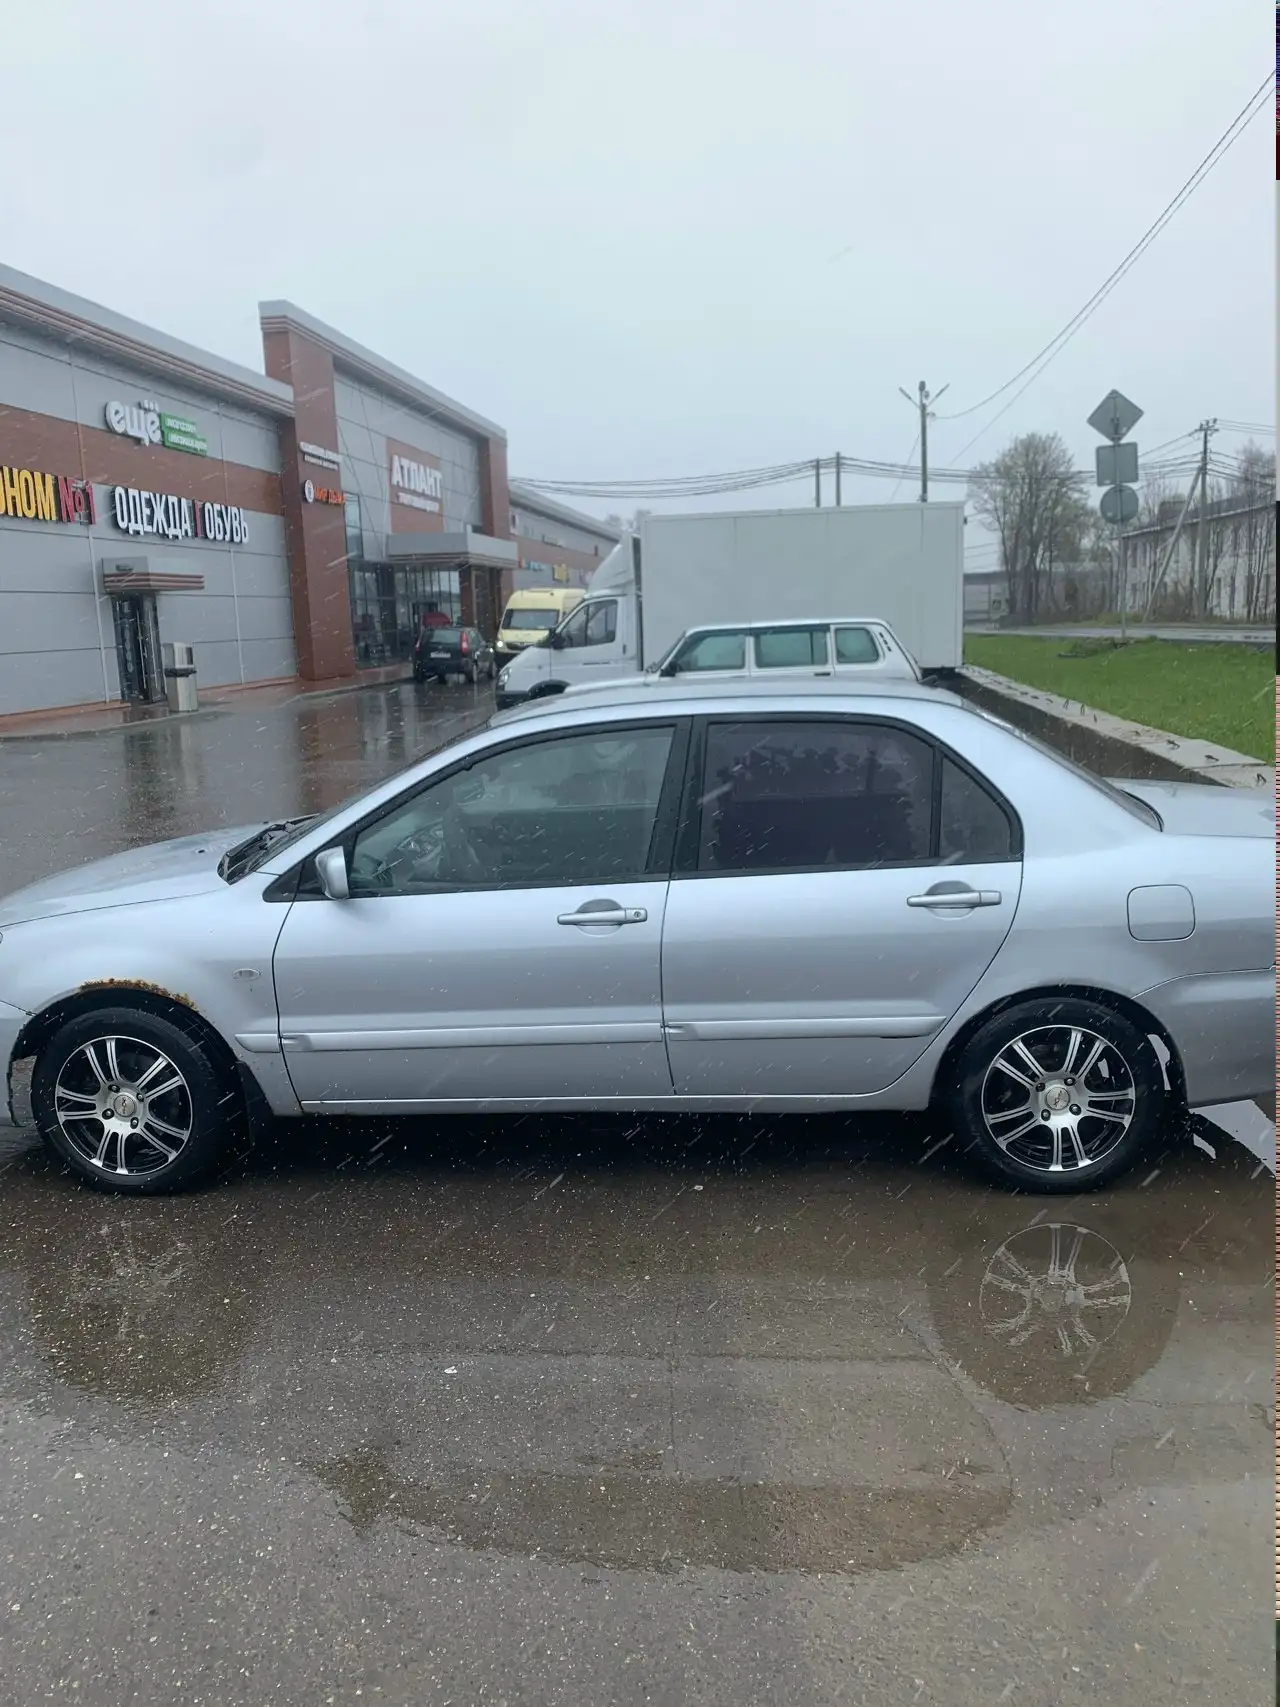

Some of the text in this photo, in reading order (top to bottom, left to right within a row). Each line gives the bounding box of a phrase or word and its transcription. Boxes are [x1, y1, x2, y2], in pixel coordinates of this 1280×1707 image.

[105, 400, 162, 446] ещё
[391, 454, 442, 499] АТЛАНТ
[114, 486, 250, 544] ОДЕЖДА ОБУВЬ
